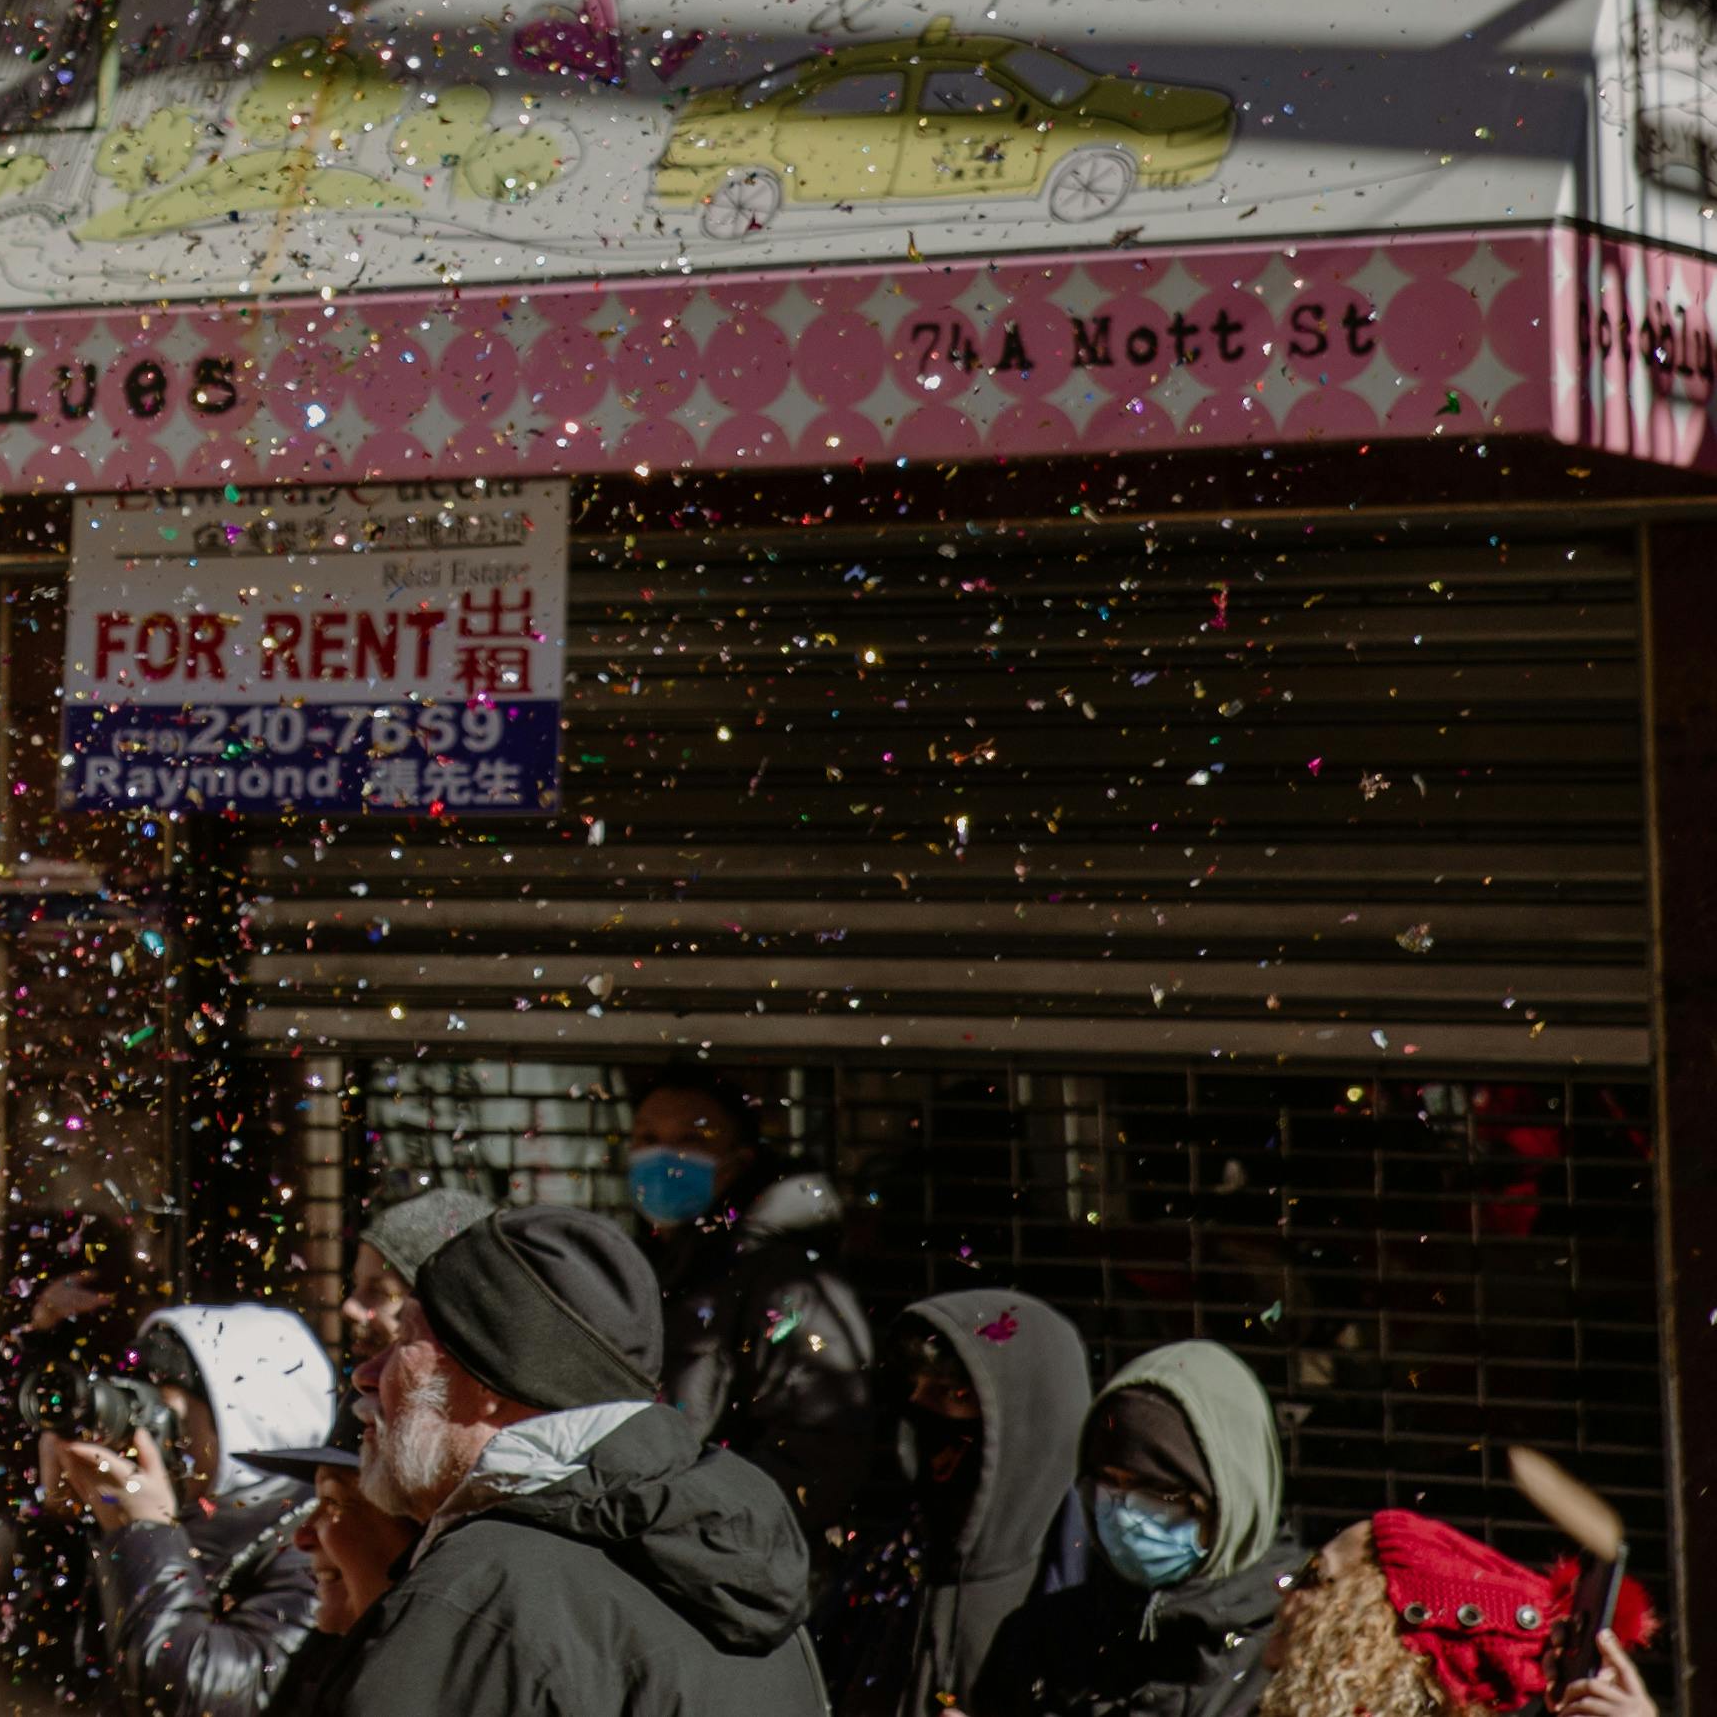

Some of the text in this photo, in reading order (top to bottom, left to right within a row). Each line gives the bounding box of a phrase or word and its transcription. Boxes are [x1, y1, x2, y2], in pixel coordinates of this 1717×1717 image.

[1072, 308, 1250, 368] Mott
[1286, 301, 1378, 359] St
[95, 610, 446, 680] FOR RENT
[456, 588, 536, 696] 出租
[84, 754, 342, 807] Raymond
